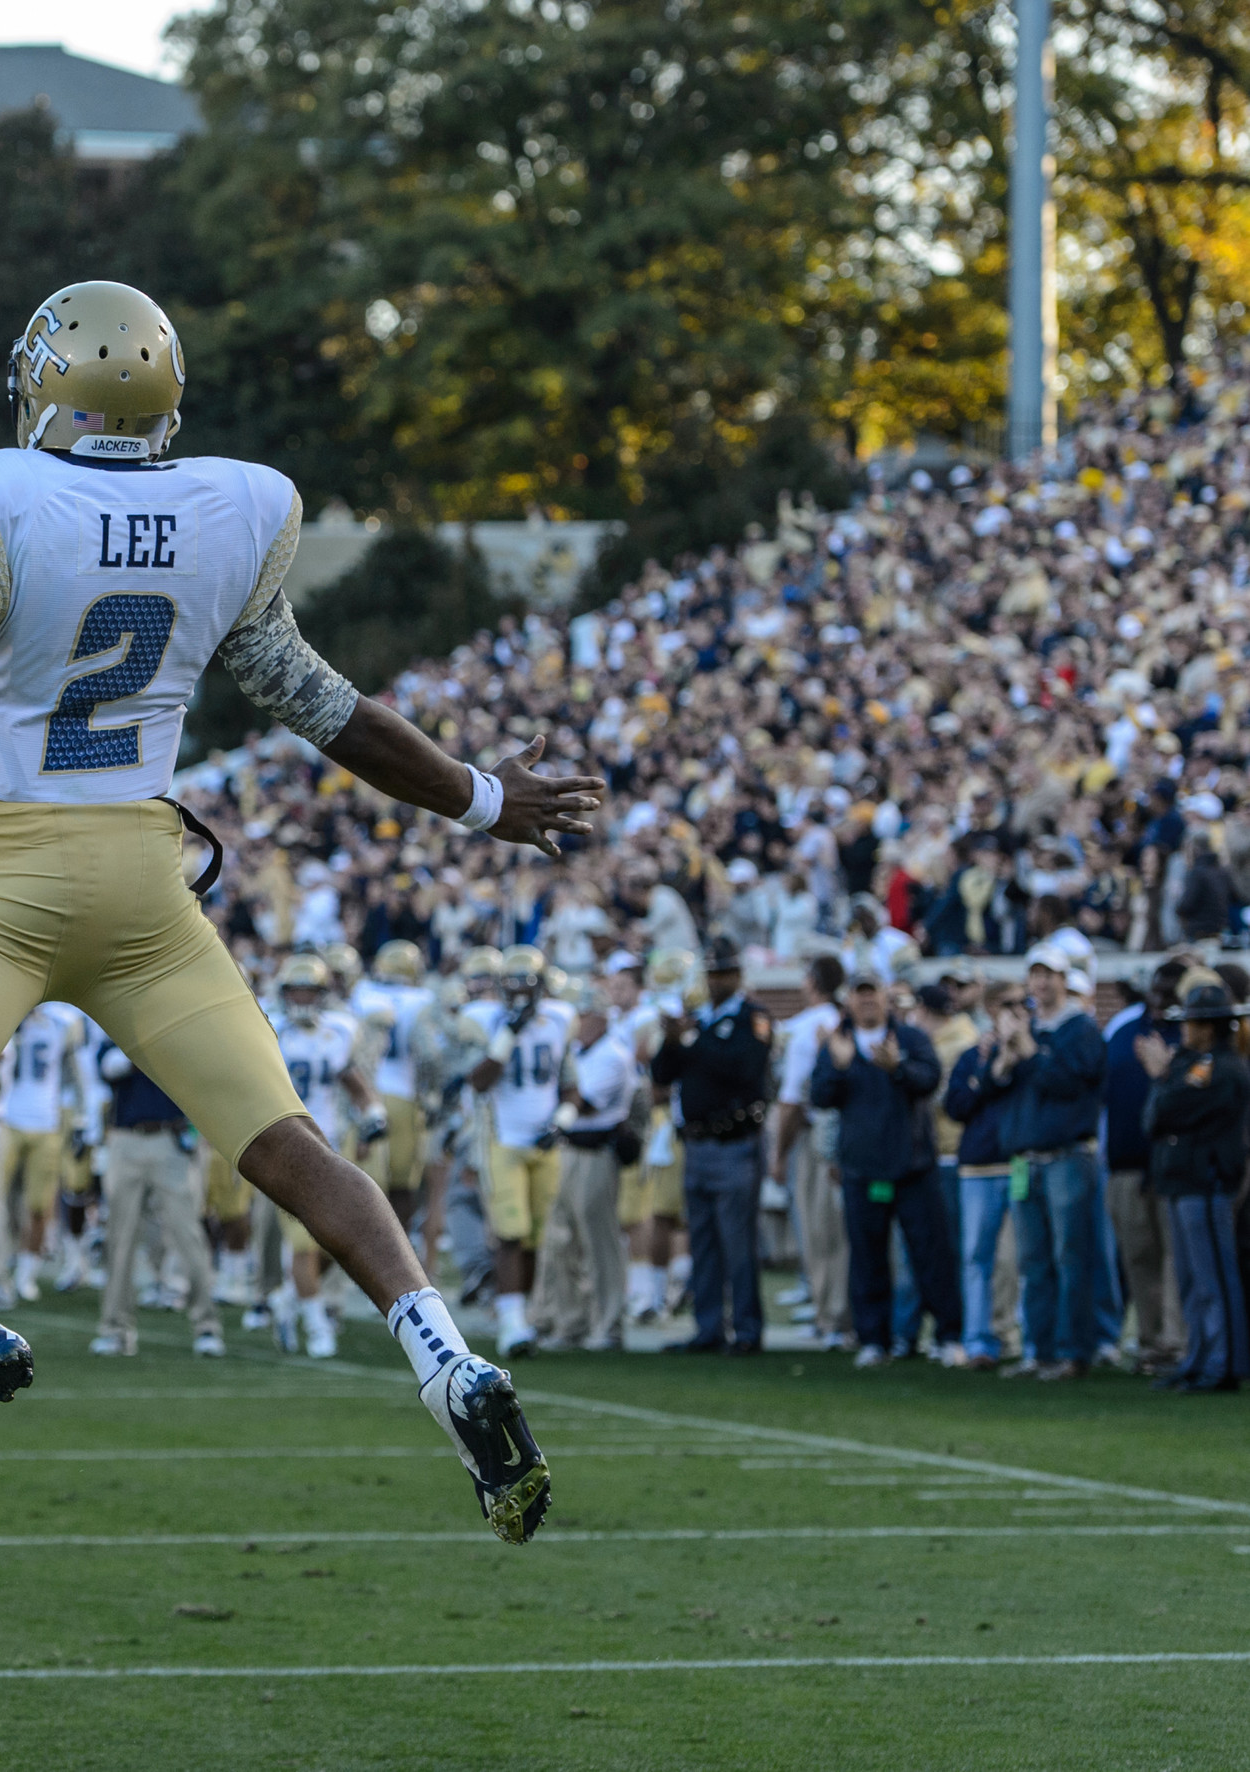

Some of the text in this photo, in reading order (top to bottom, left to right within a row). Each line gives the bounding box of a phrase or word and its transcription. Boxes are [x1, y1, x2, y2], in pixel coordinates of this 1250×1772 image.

[24, 306, 70, 389] GT
[91, 439, 141, 453] JACKETS
[116, 417, 125, 431] 2
[98, 513, 177, 568] LEE
[38, 590, 179, 776] 2
